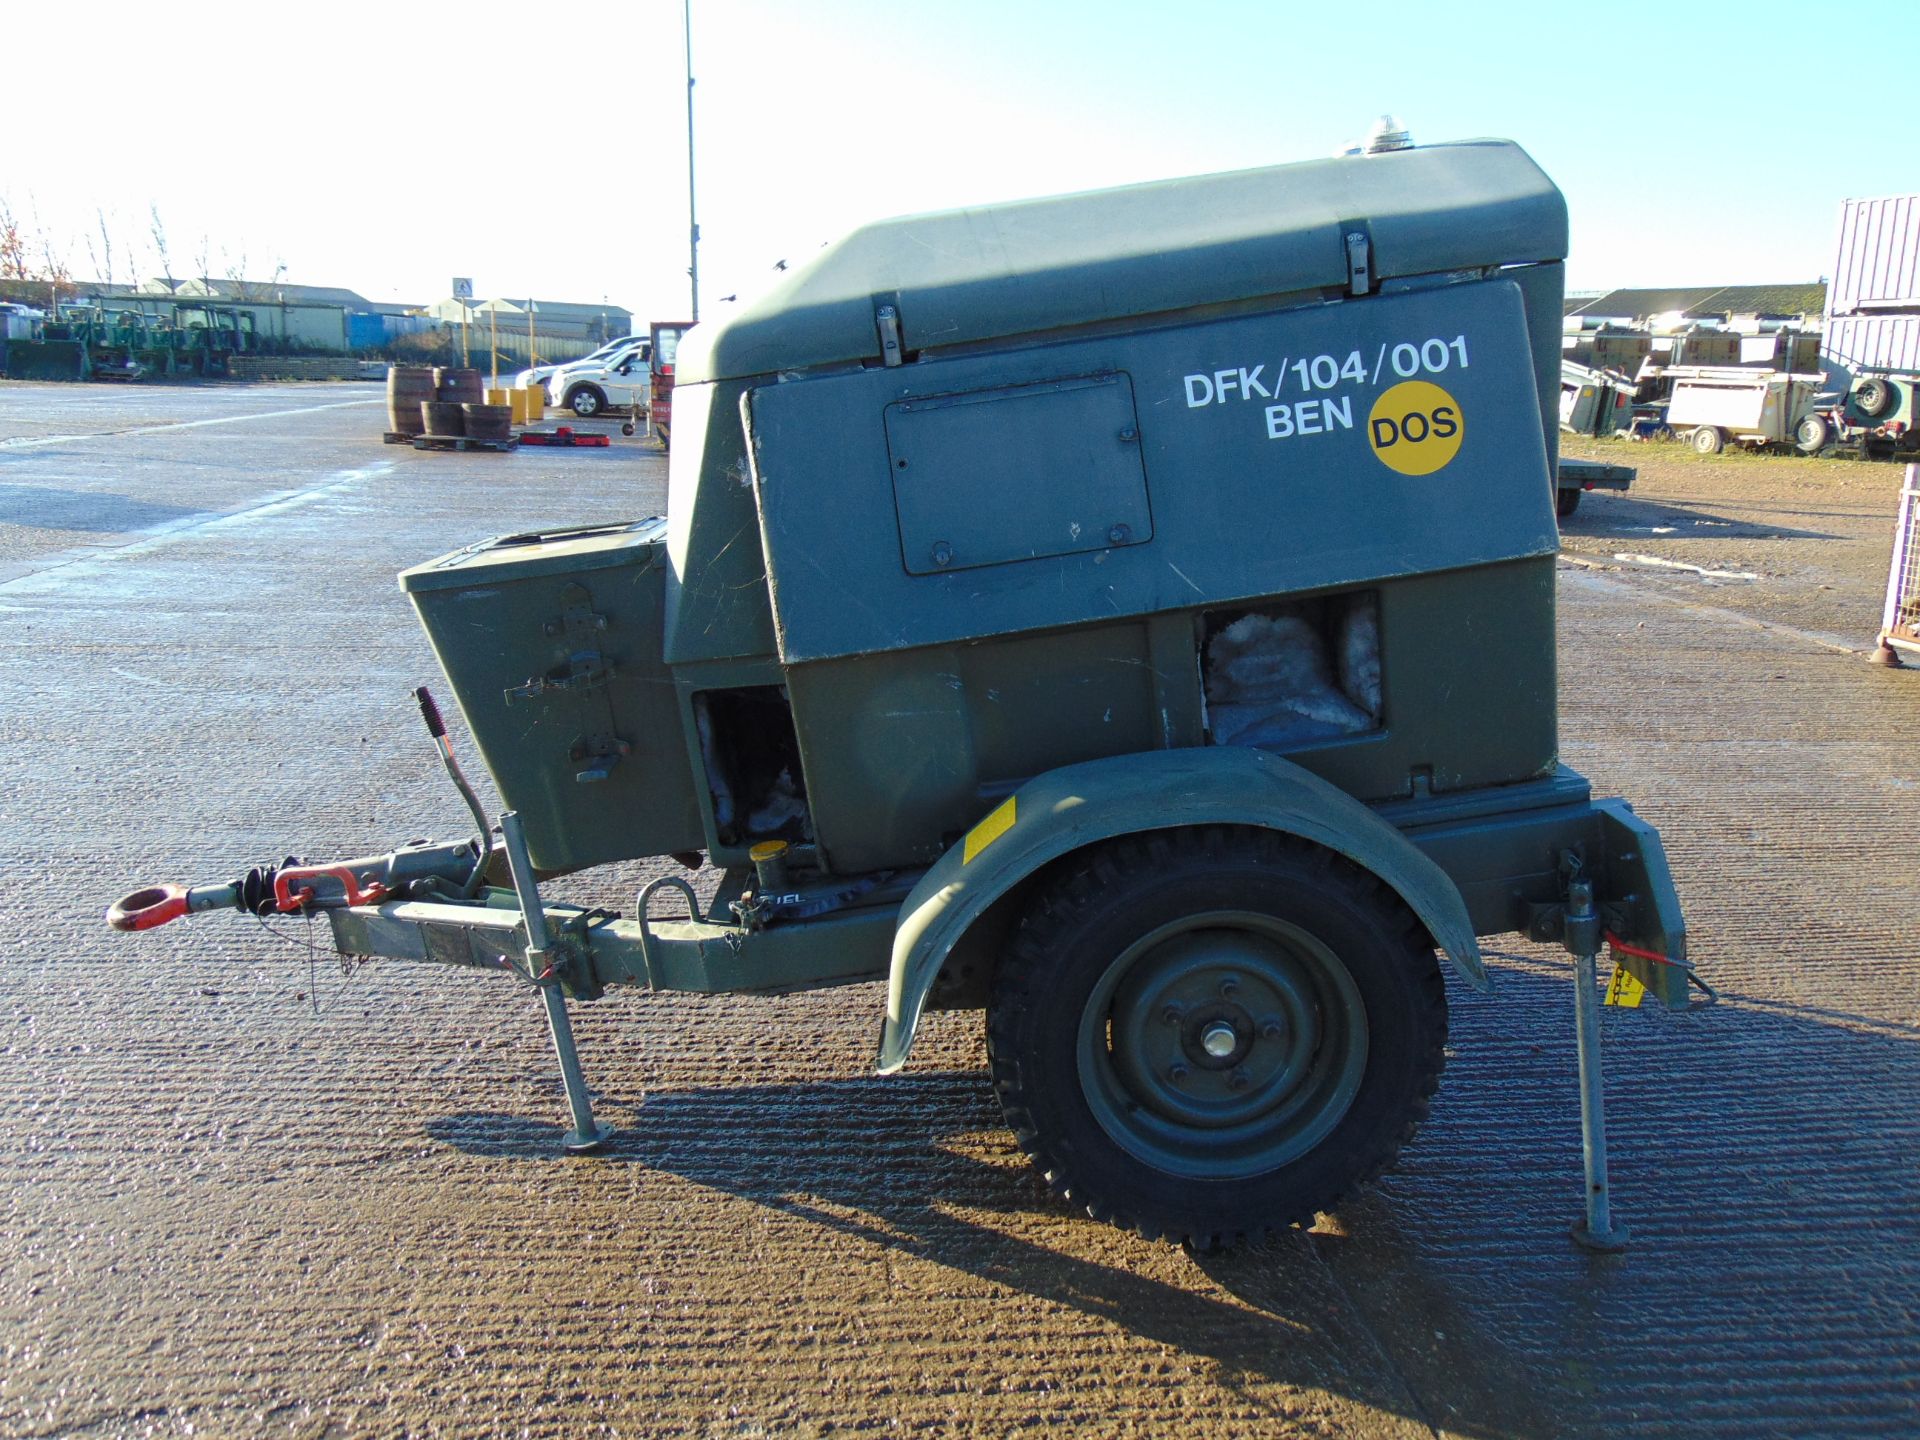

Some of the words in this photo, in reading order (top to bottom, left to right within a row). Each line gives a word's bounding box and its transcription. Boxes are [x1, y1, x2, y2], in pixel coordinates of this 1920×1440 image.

[1184, 335, 1469, 408] DFK/104/001
[1265, 396, 1353, 439] BEN
[1371, 406, 1458, 449] DOS
